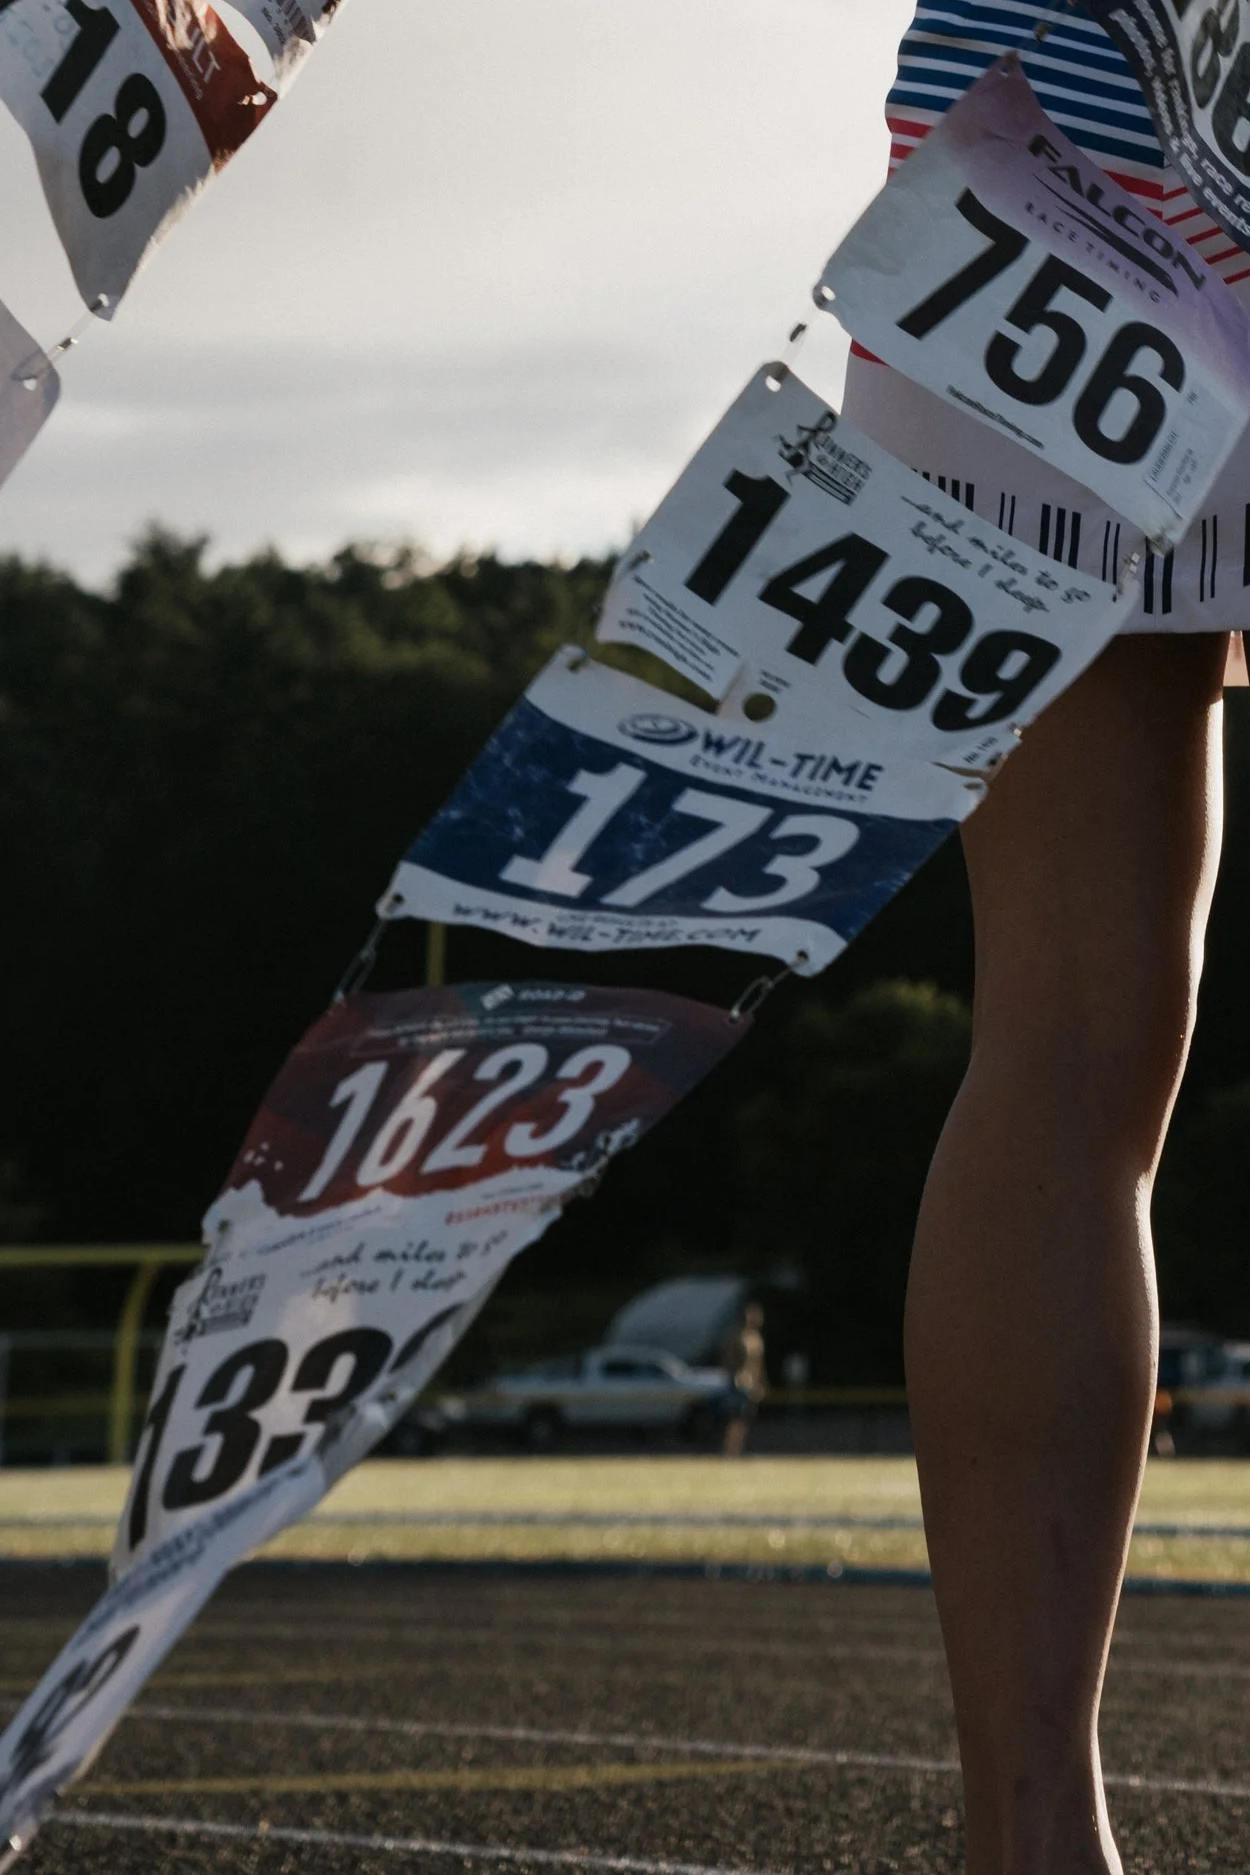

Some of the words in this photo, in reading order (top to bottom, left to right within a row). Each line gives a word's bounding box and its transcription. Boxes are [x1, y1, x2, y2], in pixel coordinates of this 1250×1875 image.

[1026, 133, 1207, 292] FALCON
[1199, 156, 1235, 197] race
[896, 186, 1187, 466] 756
[684, 468, 1063, 734] 1439
[499, 761, 861, 913] 173
[702, 733, 884, 792] WIL-TIME
[297, 1042, 632, 1203] 1623
[128, 1303, 466, 1553] 133
